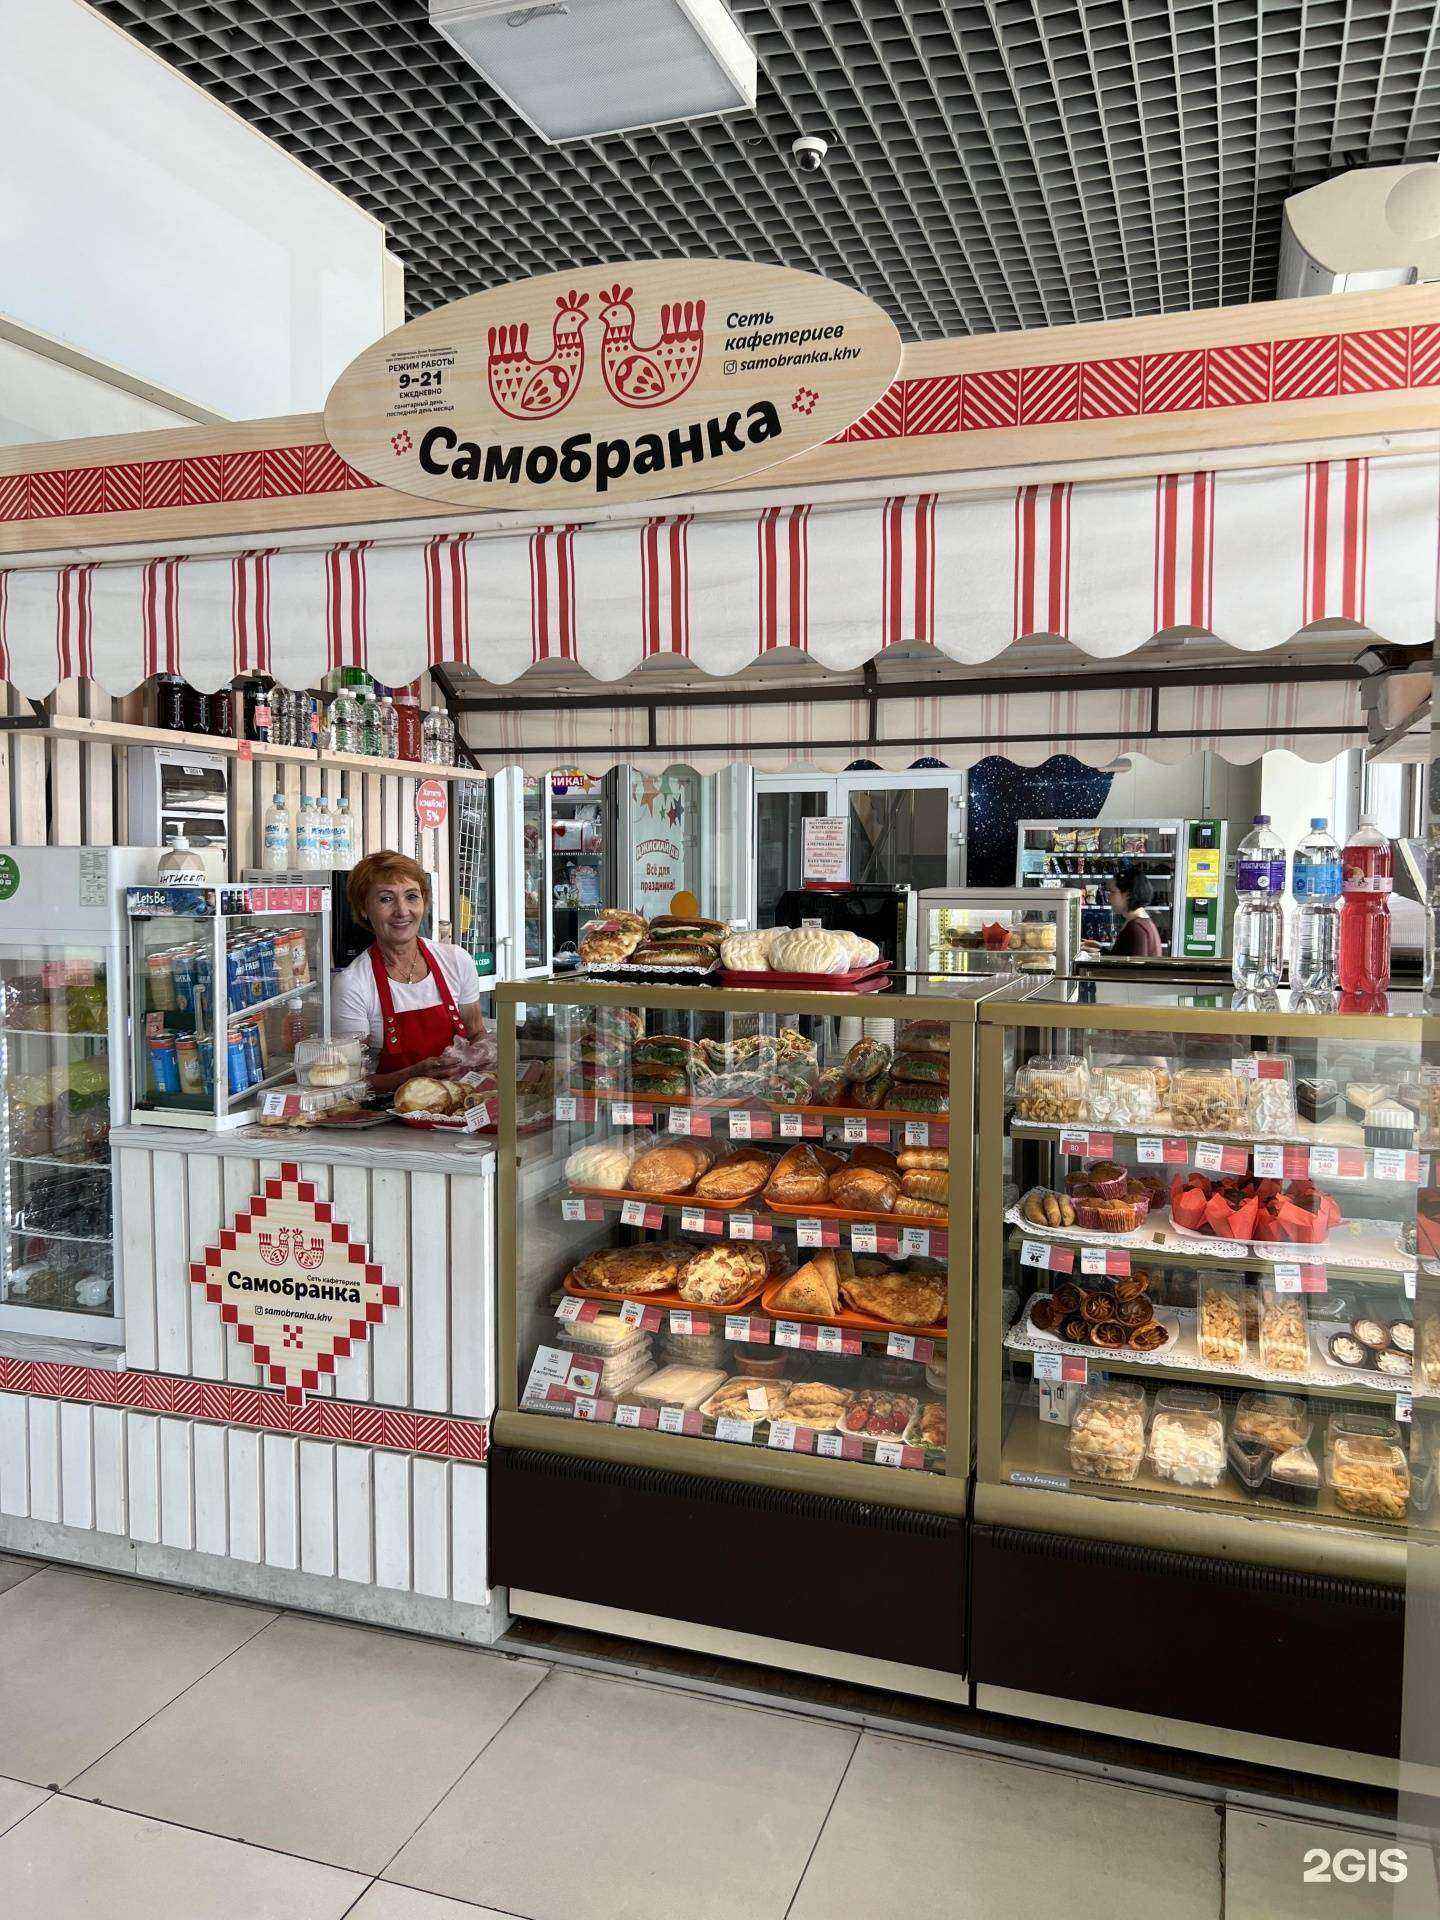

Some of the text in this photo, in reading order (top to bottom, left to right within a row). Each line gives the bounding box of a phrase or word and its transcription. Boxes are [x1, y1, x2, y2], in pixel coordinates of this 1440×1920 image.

[726, 312, 774, 329] Сеть
[725, 325, 844, 351] кафетериев
[388, 358, 455, 372] РЕЖИМ РАБОТЫ
[740, 346, 861, 371] samobranka.khv
[399, 370, 442, 389] 9-21
[399, 388, 442, 399] ЕЖЕДНЕВНО
[418, 399, 782, 492] Самобранка
[227, 1270, 361, 1303] Самобранка
[264, 1306, 333, 1322] samobranka.khv
